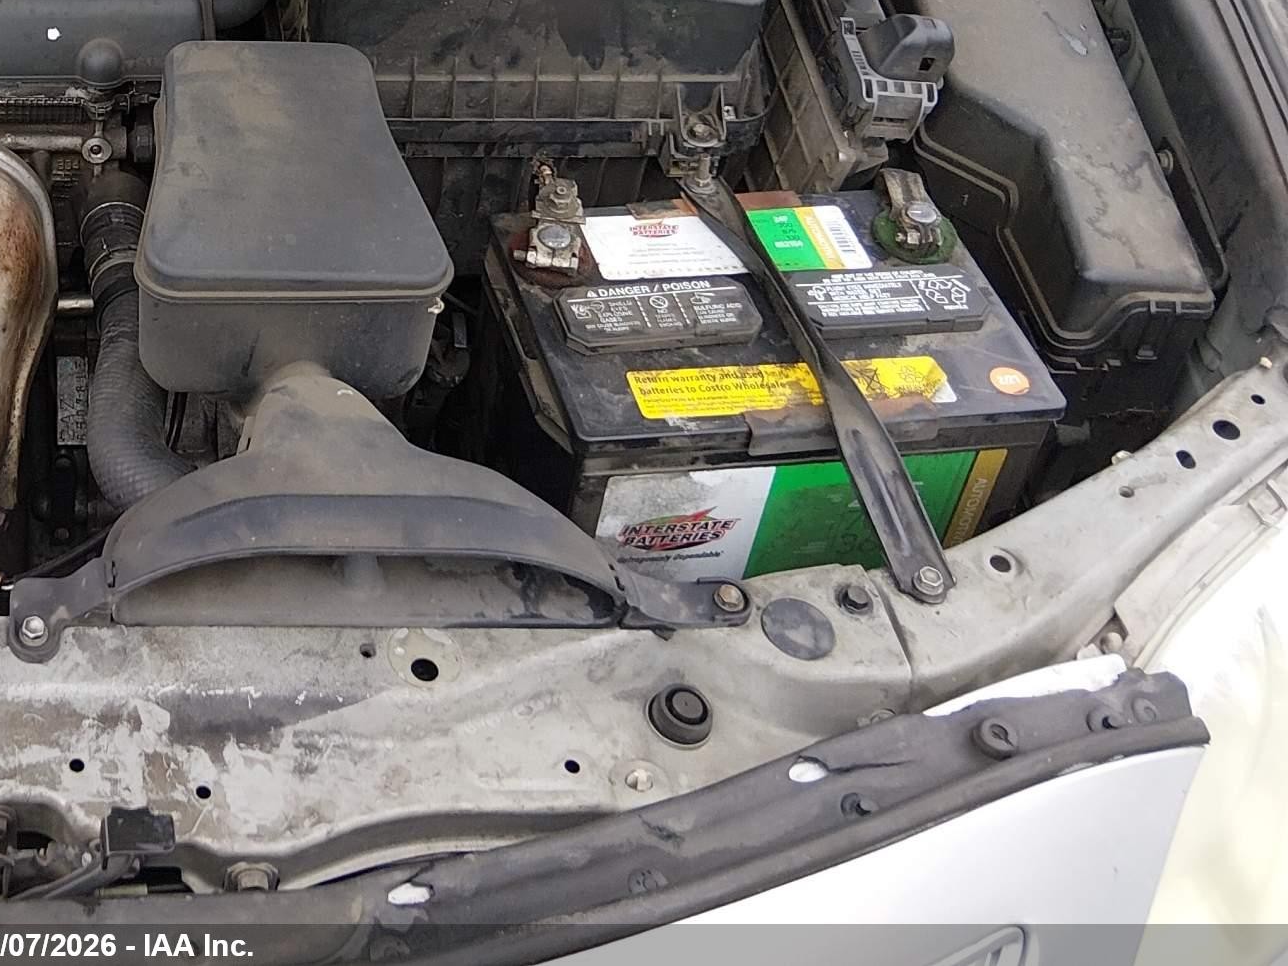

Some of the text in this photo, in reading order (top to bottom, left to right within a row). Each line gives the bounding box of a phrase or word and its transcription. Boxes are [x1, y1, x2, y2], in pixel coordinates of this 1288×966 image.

[629, 223, 679, 232] INTERSTATE
[598, 285, 650, 297] DANGER
[662, 280, 711, 291] POISON
[634, 374, 669, 385] Return
[671, 372, 717, 384] warranty
[719, 371, 737, 380] and
[740, 370, 763, 380] used
[639, 380, 787, 396] batteries to Costco Wholesale
[620, 519, 735, 536] INTERSTATE
[623, 530, 724, 547] BATTERIES
